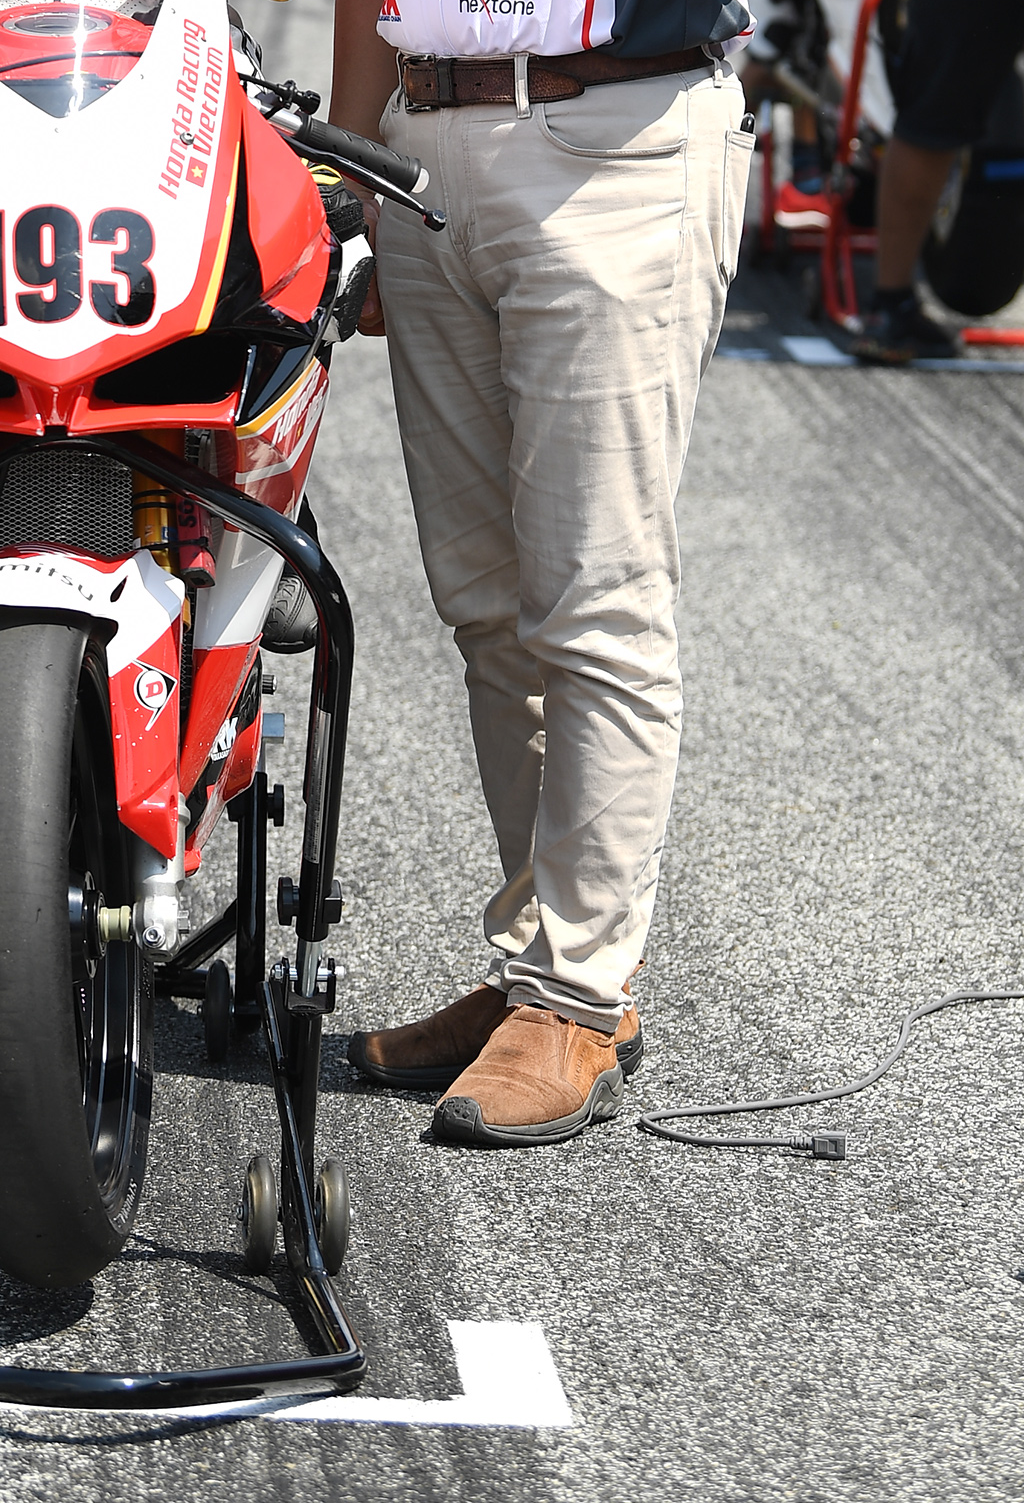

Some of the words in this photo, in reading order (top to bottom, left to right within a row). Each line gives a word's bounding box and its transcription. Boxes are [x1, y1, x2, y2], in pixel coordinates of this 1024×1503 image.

[176, 17, 207, 104] Racing
[192, 46, 224, 157] Vietnam
[158, 116, 195, 200] Honda
